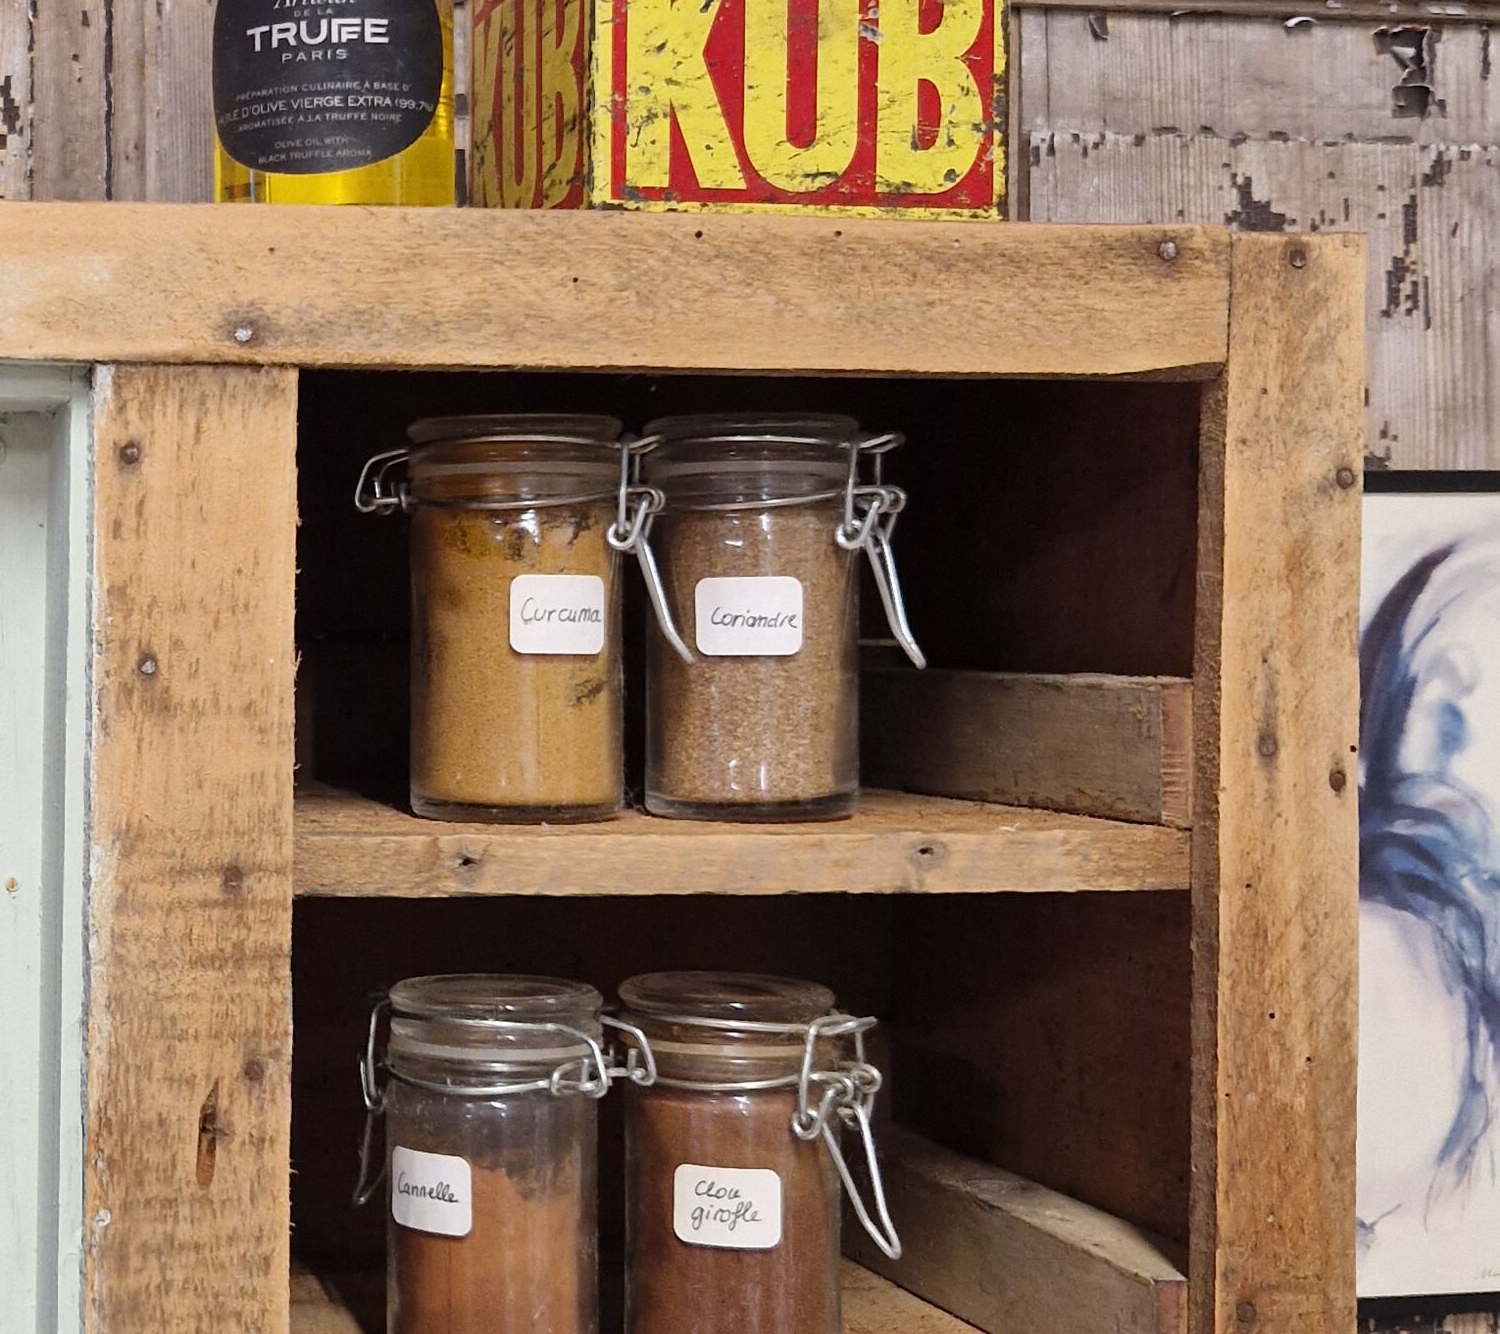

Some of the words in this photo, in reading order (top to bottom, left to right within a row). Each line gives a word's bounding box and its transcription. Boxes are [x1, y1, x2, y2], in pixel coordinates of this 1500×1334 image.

[293, 9, 310, 18] DE
[316, 7, 334, 16] LA
[281, 48, 349, 64] PARIS
[241, 99, 288, 117] D'OLIVE
[290, 95, 344, 110] VIERGE
[347, 95, 392, 108] EXTRA
[274, 139, 303, 150] OLIVE
[520, 596, 602, 625] Curcuma
[710, 605, 798, 629] Coriandre
[397, 1170, 460, 1204] Cannelle
[694, 1179, 741, 1200] Clou
[690, 1200, 763, 1232] girofle
